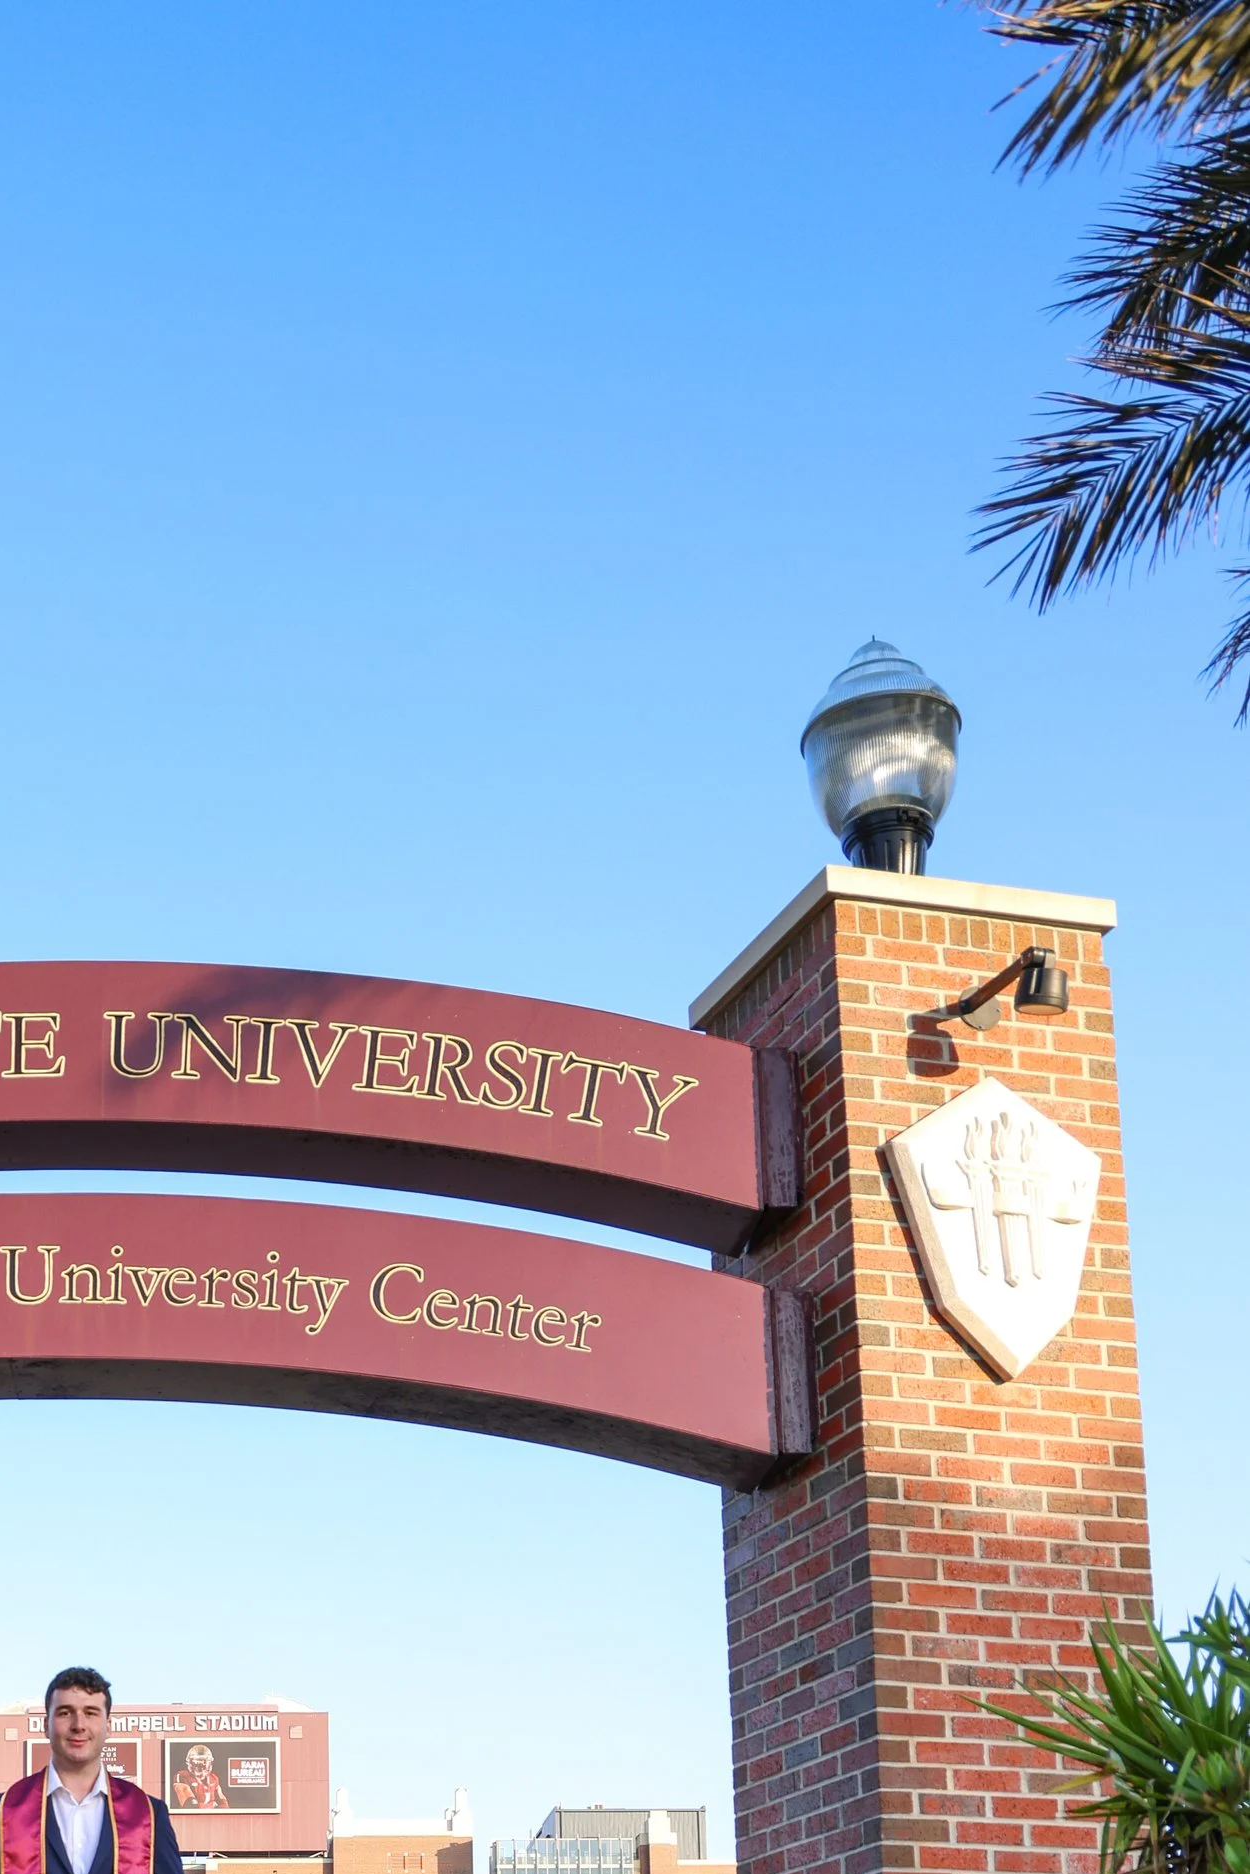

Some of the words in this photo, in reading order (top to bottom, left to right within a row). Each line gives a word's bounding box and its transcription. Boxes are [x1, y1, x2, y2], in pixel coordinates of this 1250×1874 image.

[104, 1011, 699, 1142] UNIVERSITY
[0, 1245, 350, 1336] University
[370, 1263, 603, 1353] Center
[111, 1715, 186, 1732] MPBELL
[195, 1715, 279, 1731] STADIUM
[231, 1769, 266, 1777] BUREAU
[241, 1761, 266, 1769] FARM
